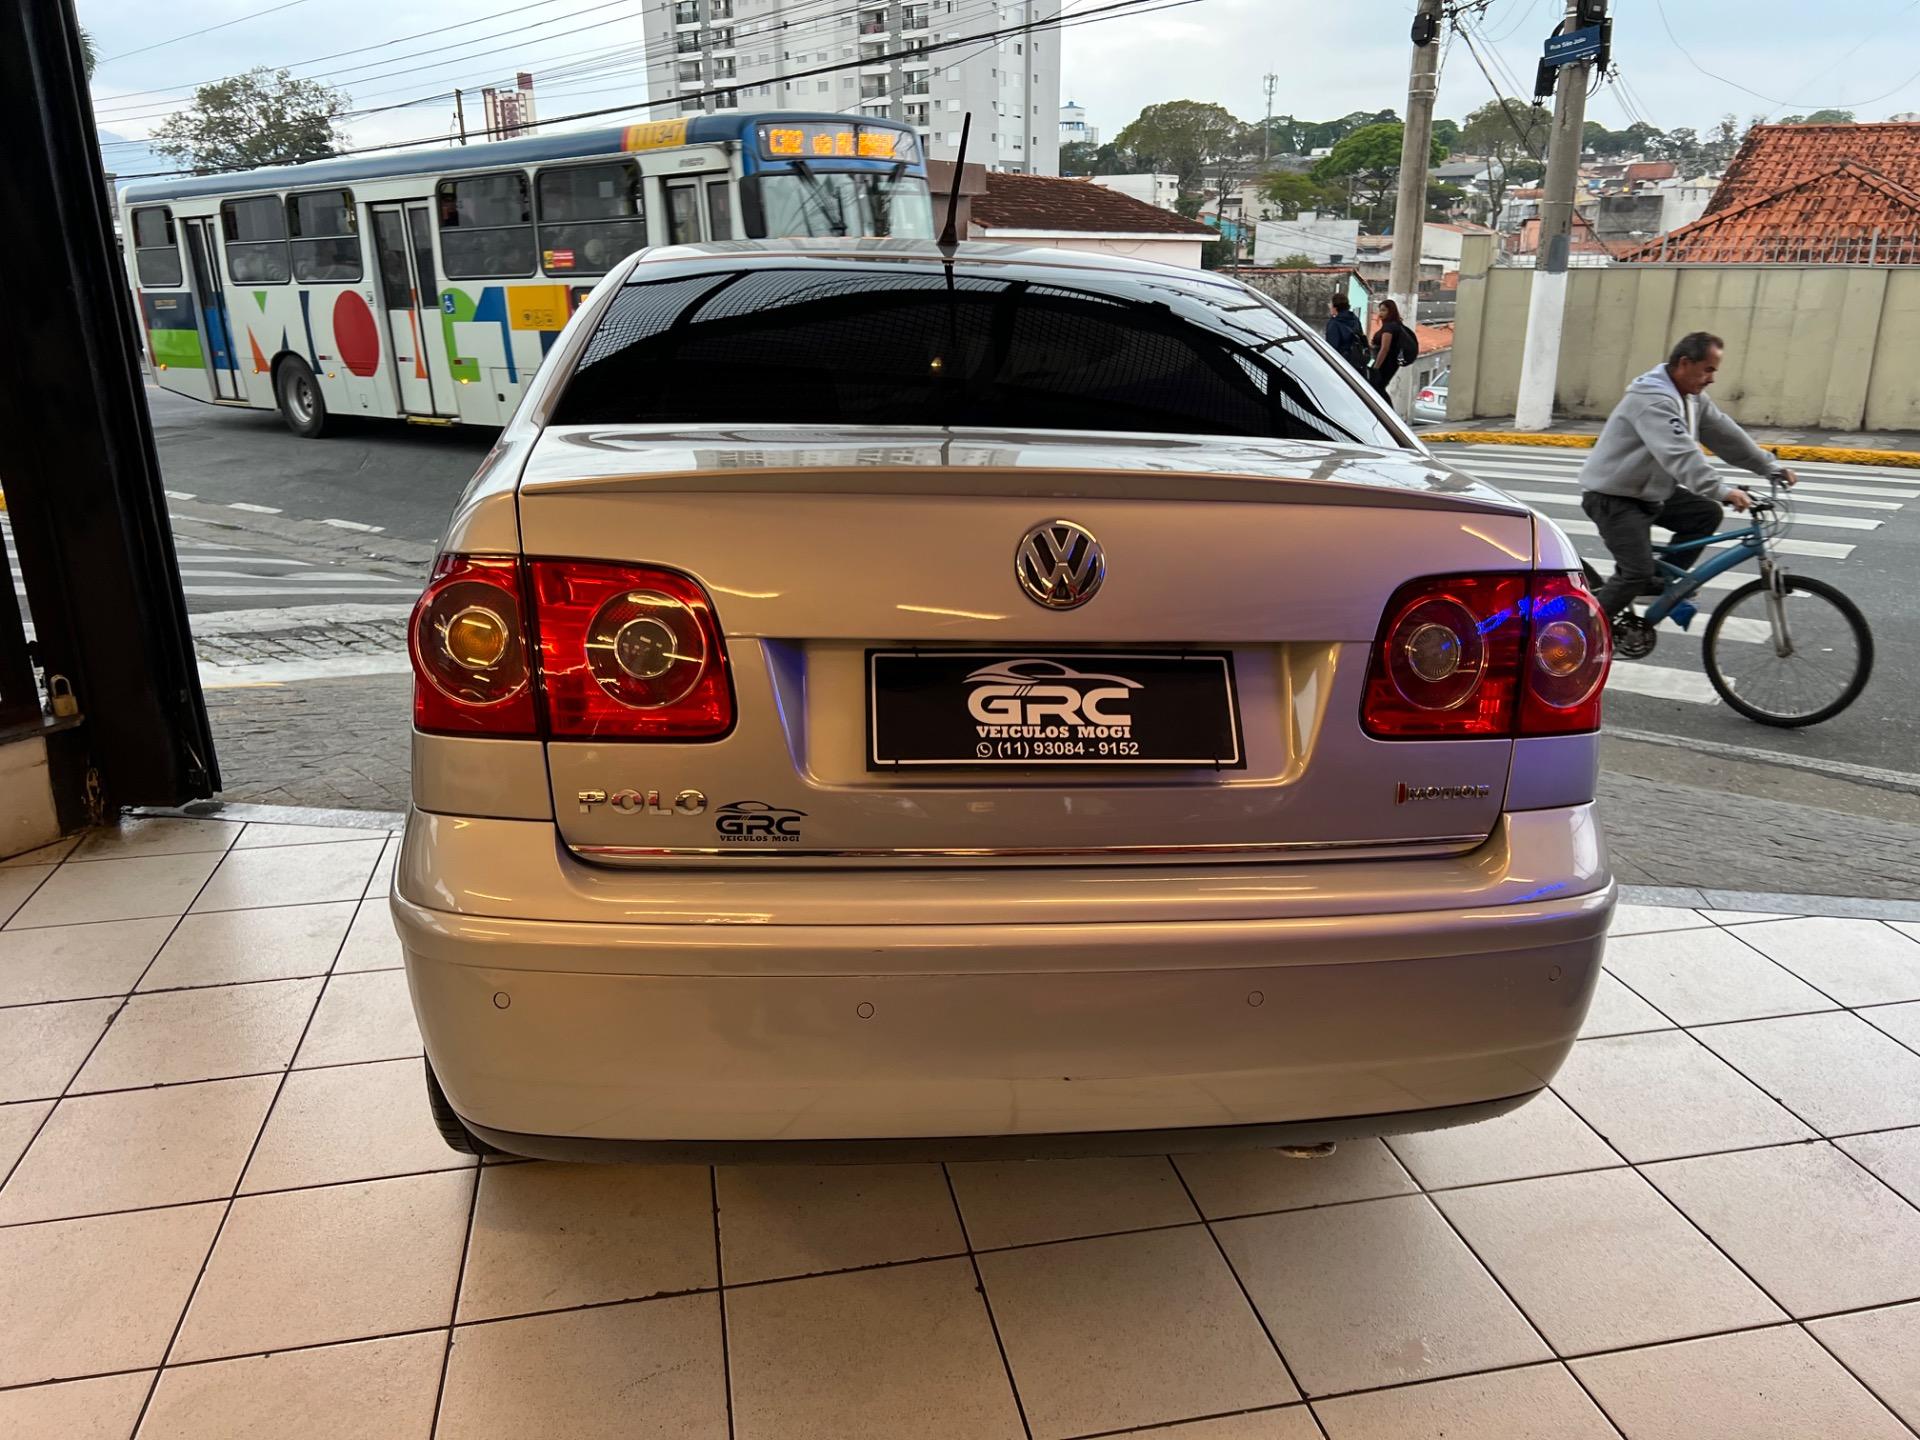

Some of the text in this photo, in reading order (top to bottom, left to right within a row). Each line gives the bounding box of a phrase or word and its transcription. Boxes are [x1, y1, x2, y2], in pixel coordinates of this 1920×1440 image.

[966, 684, 1133, 726] GRC
[976, 725, 1132, 739] VEICULOS MOGI
[997, 741, 1029, 759] (11)
[578, 788, 709, 816] POLO
[715, 814, 801, 836] GRC
[720, 835, 800, 843] VEICULOS MOGI
